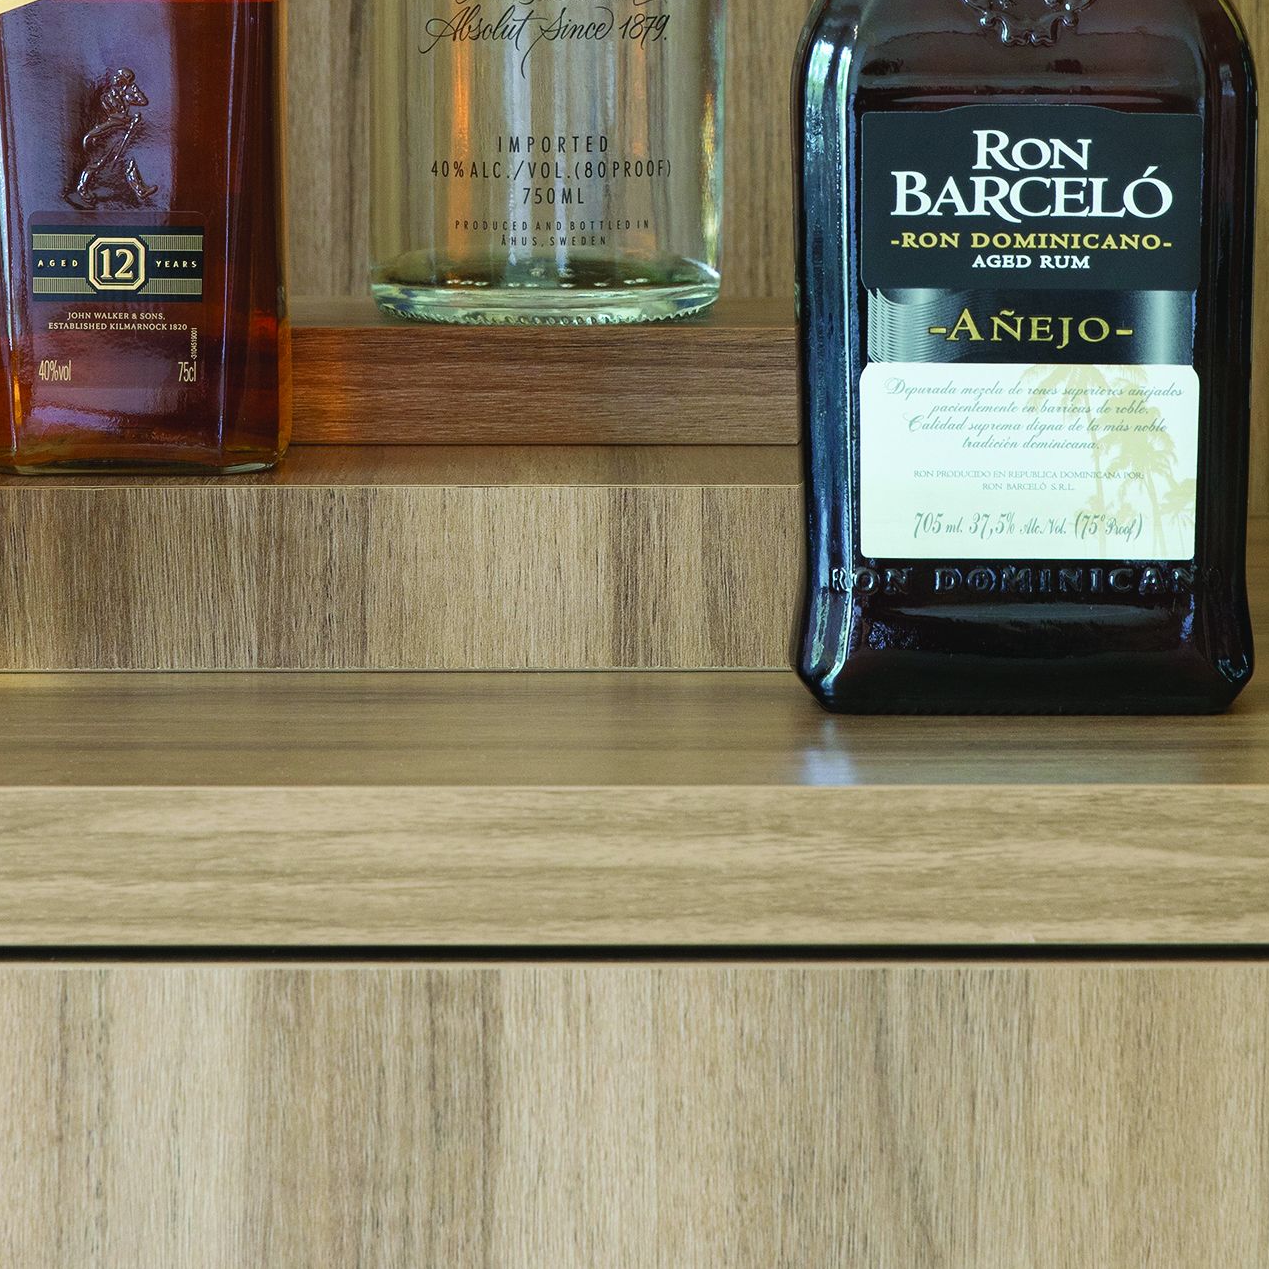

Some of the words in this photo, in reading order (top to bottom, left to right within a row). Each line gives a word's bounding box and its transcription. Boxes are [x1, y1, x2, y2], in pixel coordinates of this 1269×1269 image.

[418, 4, 548, 54] Absolut
[619, 14, 670, 49] 1879.
[498, 135, 609, 154] IMPORTED
[455, 220, 528, 231] PRODUCED
[535, 221, 562, 231] AND
[569, 219, 631, 231] BOTTLED
[637, 219, 649, 229] IN
[550, 236, 606, 246] SWEDEN
[37, 259, 79, 268] AGED
[100, 247, 135, 280] 12
[155, 259, 197, 269] YEARS
[972, 254, 1032, 269] AGED
[1040, 255, 1090, 269] RUM
[67, 312, 91, 320] JOHN
[94, 312, 129, 320] WALKER
[131, 312, 138, 320] &
[48, 322, 108, 330] ESTABLISHED
[109, 322, 167, 331] KILMARNOCK
[170, 323, 188, 331] 1820
[178, 361, 197, 382] 75cl
[883, 377, 957, 401] Depurada
[1008, 380, 1023, 395] de
[1027, 387, 1058, 396] rones
[1062, 386, 1124, 402] superiores
[927, 401, 1018, 419] pacientemente
[1040, 399, 1091, 414] barricas
[1096, 399, 1112, 414] de
[902, 412, 965, 433] Calidad
[968, 422, 1022, 437] suprema
[1026, 417, 1064, 438] digna
[1068, 417, 1085, 431] de
[1087, 417, 1101, 431] la
[1133, 418, 1168, 432] noble
[913, 470, 934, 478] RON
[936, 470, 992, 479] PRODUCIDO
[993, 470, 1006, 479] EN
[913, 512, 944, 539] 705
